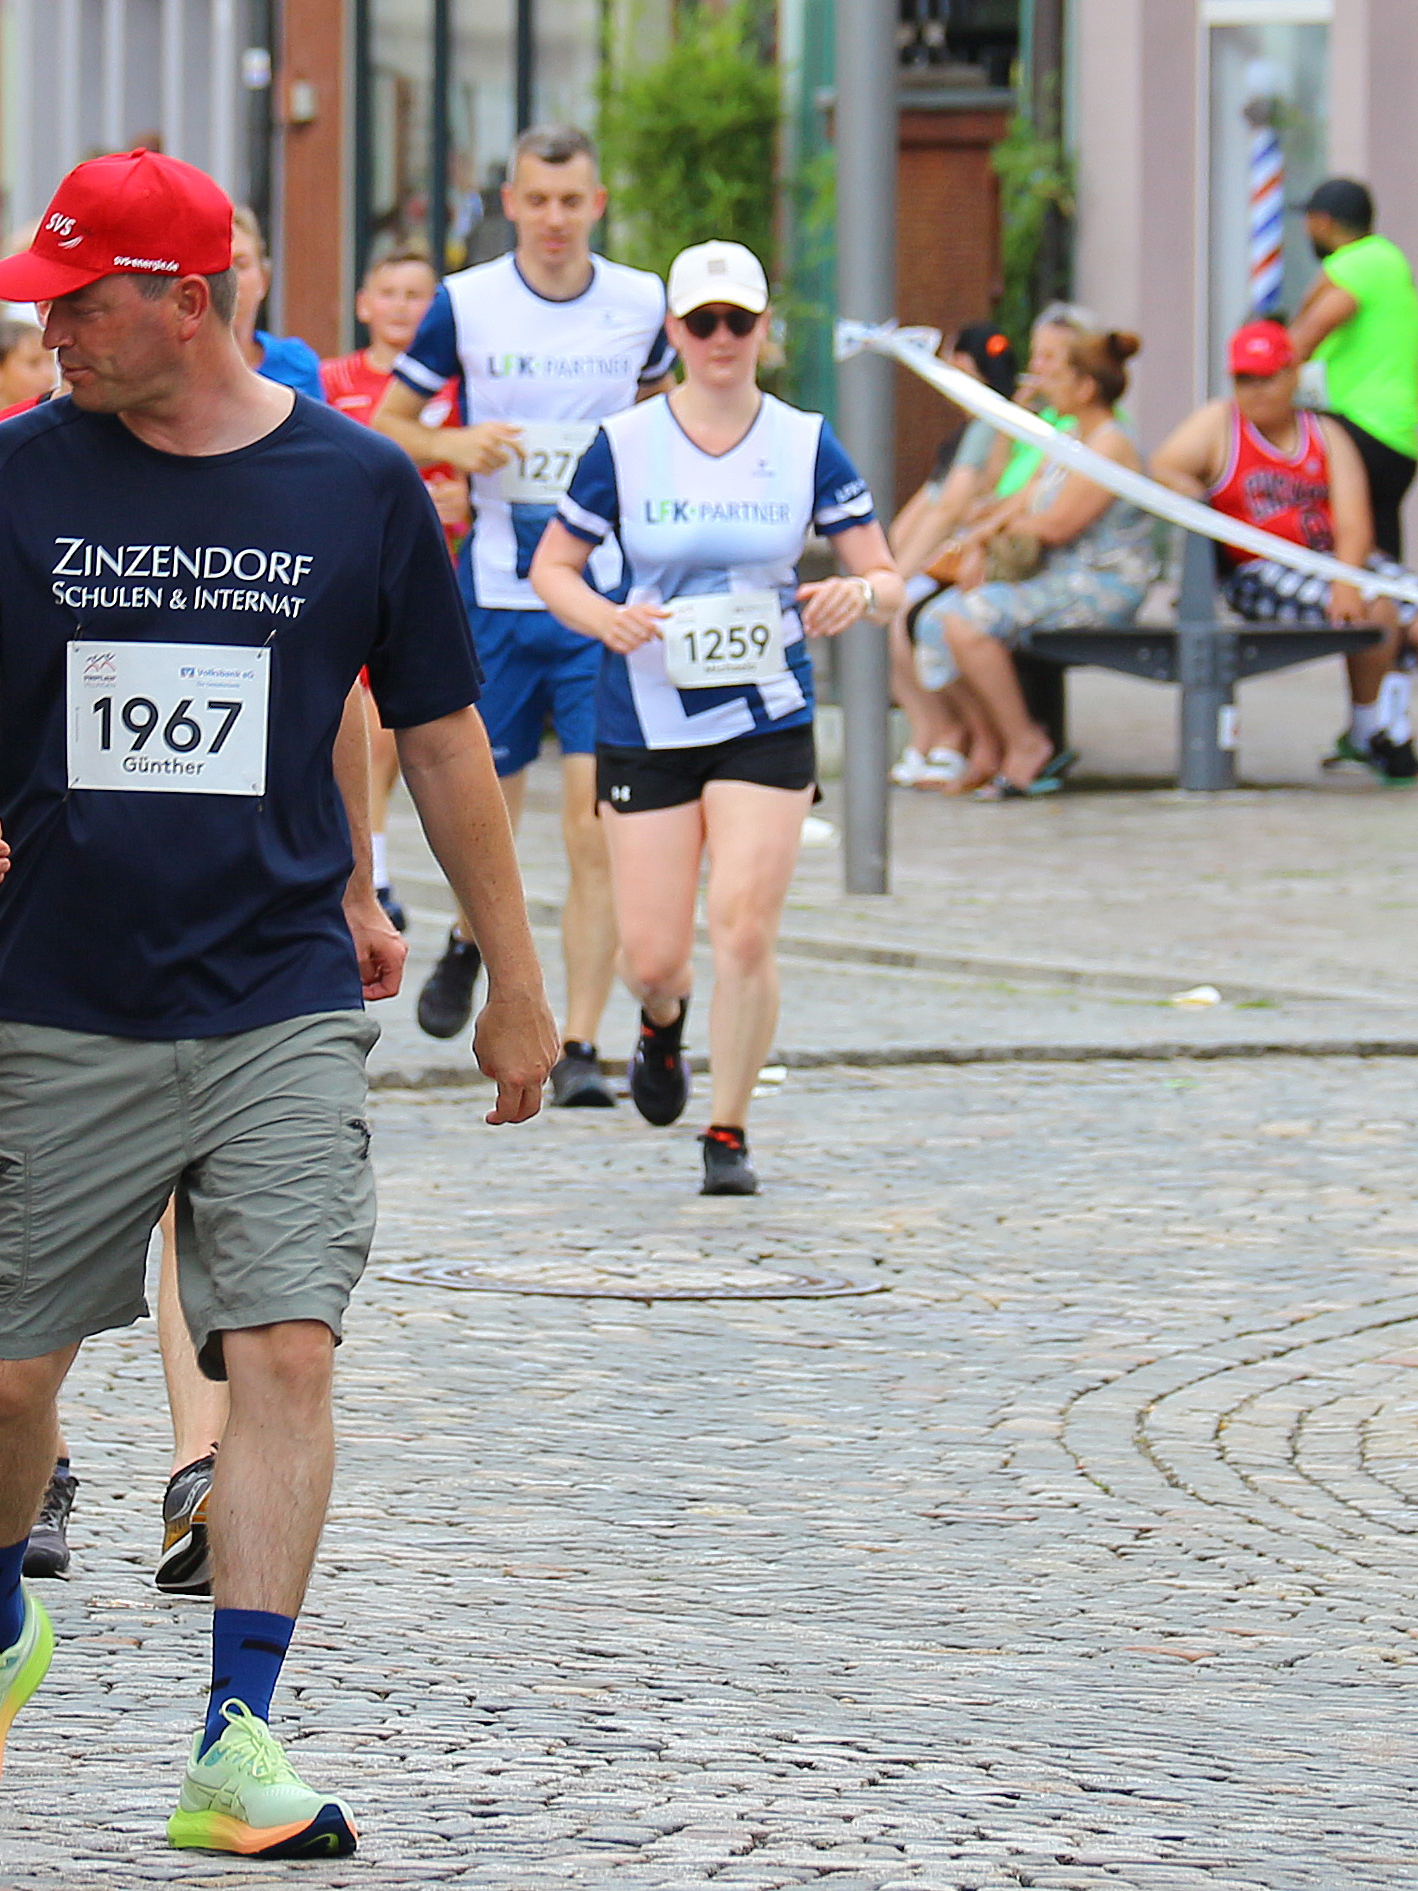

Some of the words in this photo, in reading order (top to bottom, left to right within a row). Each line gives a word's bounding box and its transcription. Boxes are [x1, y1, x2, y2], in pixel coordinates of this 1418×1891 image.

[45, 212, 76, 236] SVS
[52, 537, 313, 586] ZINZENDORF
[51, 581, 163, 610] SCHULEN
[169, 588, 187, 610] &
[193, 585, 306, 618] INTERNAT
[683, 625, 770, 663] 1259
[93, 696, 243, 755] 1967
[122, 755, 205, 776] Günther
